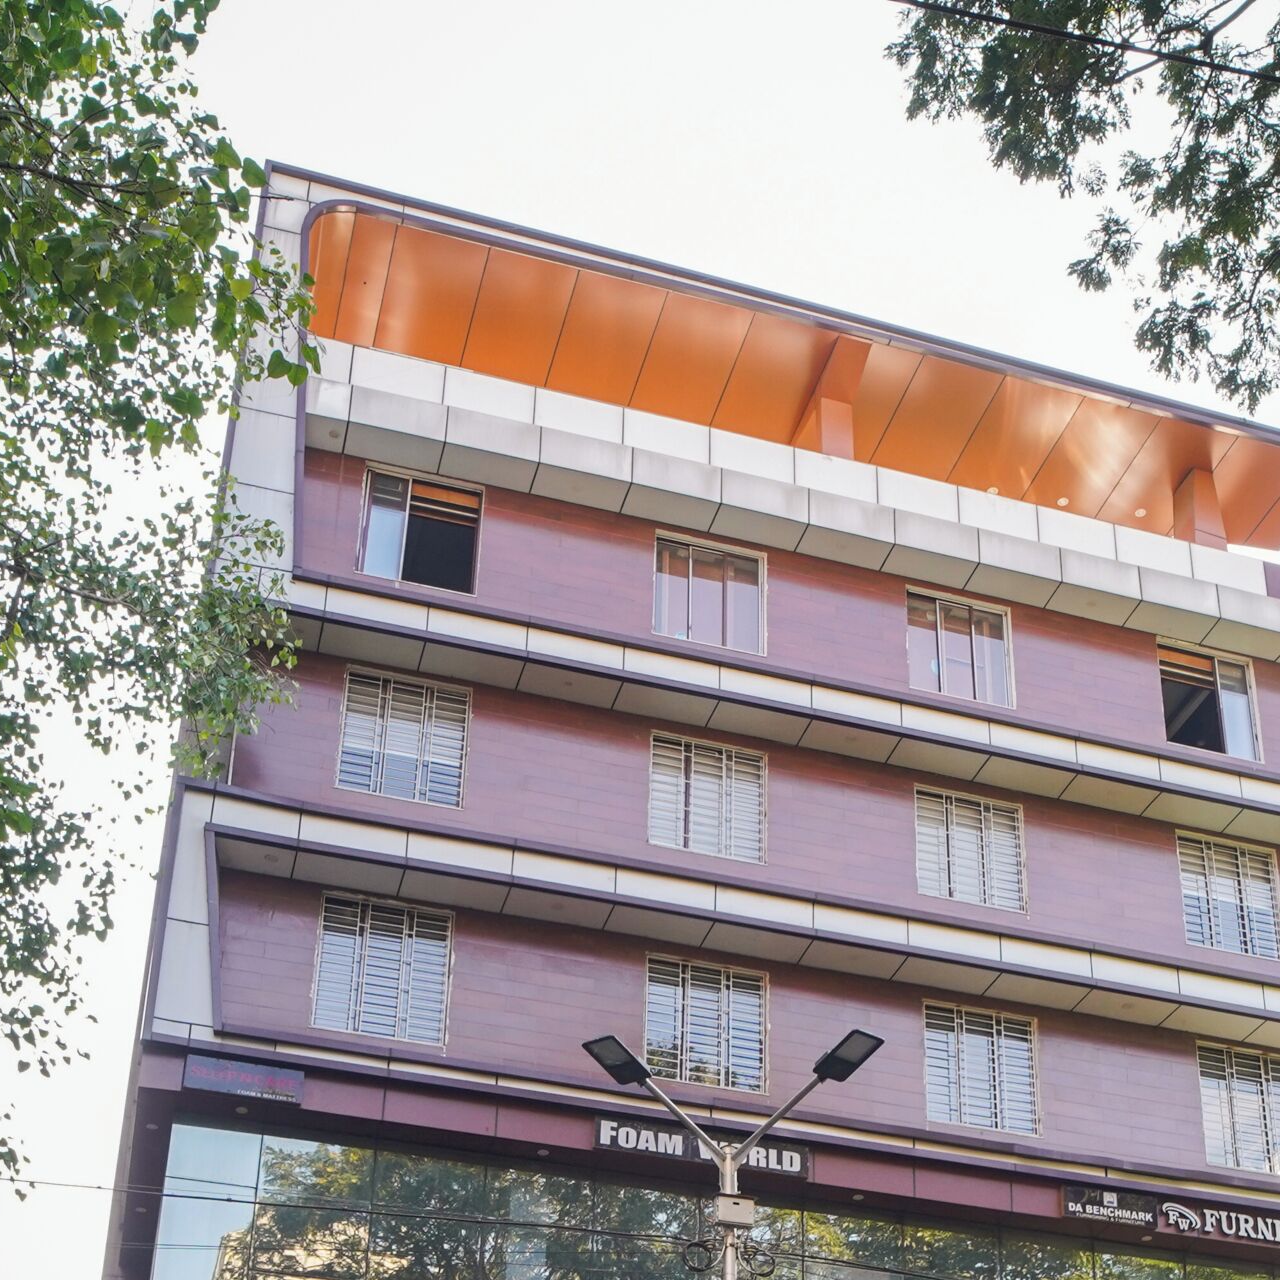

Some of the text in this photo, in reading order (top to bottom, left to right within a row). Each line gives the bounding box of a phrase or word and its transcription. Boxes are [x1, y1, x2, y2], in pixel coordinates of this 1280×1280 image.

[599, 1119, 683, 1156] FOAM
[1068, 1202, 1154, 1222] DA BENCHMARK
